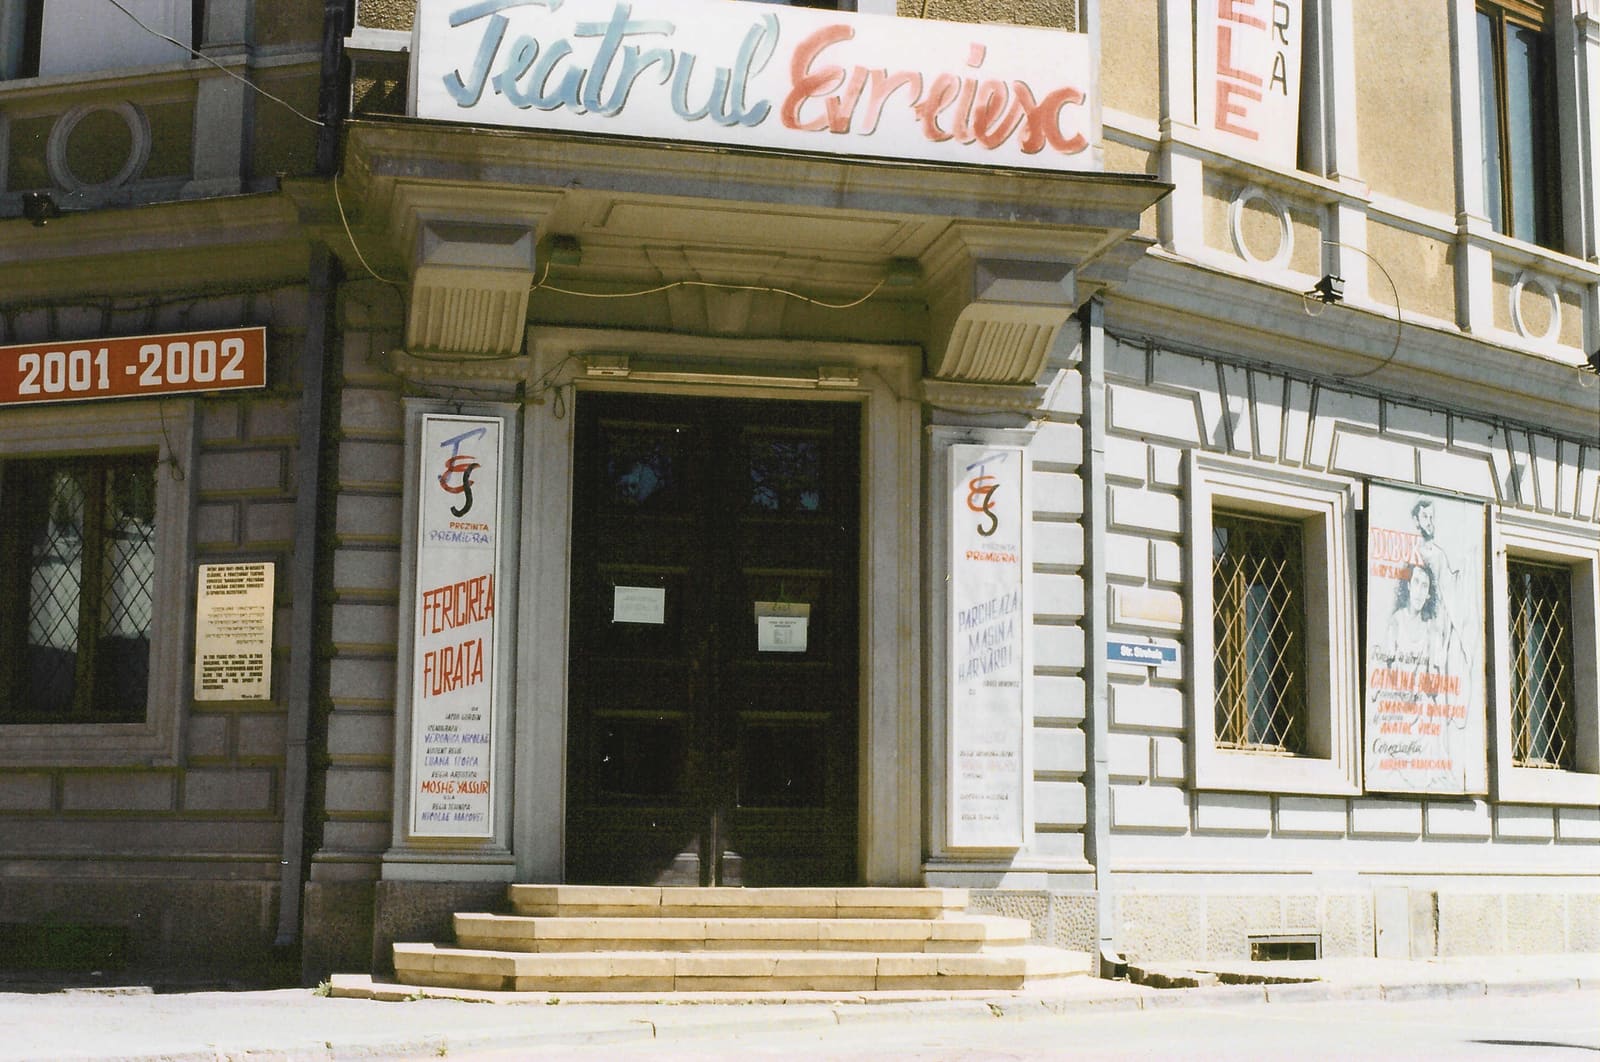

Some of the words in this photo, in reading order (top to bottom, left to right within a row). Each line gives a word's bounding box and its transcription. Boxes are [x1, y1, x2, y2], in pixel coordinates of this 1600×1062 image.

[442, 0, 779, 128] Teatrul
[780, 23, 1091, 155] Evreiesc
[18, 347, 110, 395] 2001
[965, 550, 1016, 564] PREMIERA
[423, 573, 494, 637] FERICIREA
[423, 638, 484, 699] FURATA
[421, 780, 455, 794] MOSHE
[456, 780, 488, 794] YASSUR
